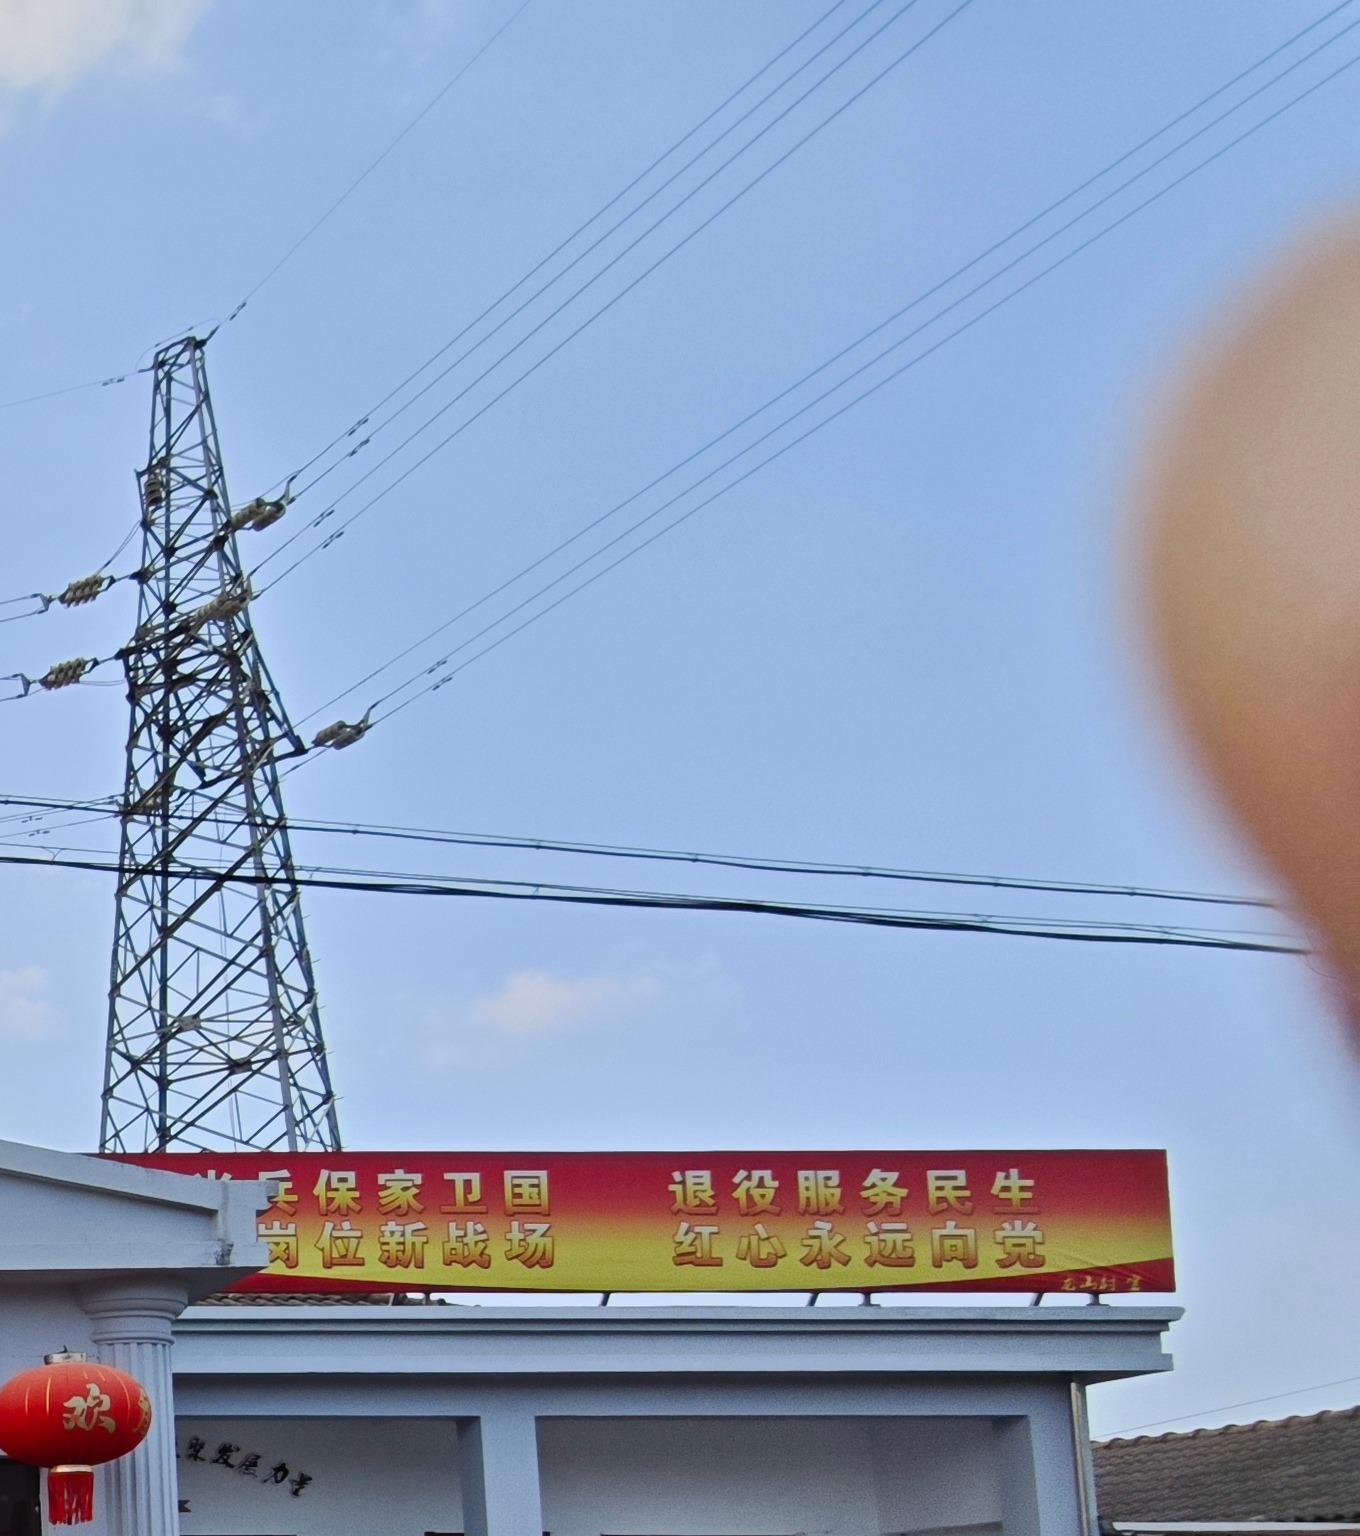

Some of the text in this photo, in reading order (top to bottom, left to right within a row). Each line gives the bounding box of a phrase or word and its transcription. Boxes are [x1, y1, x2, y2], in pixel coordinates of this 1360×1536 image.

[192, 1168, 1042, 1217] 兵保家卫国 退役服务民生
[257, 1220, 1046, 1270] 岗位新战场 红心永远向党
